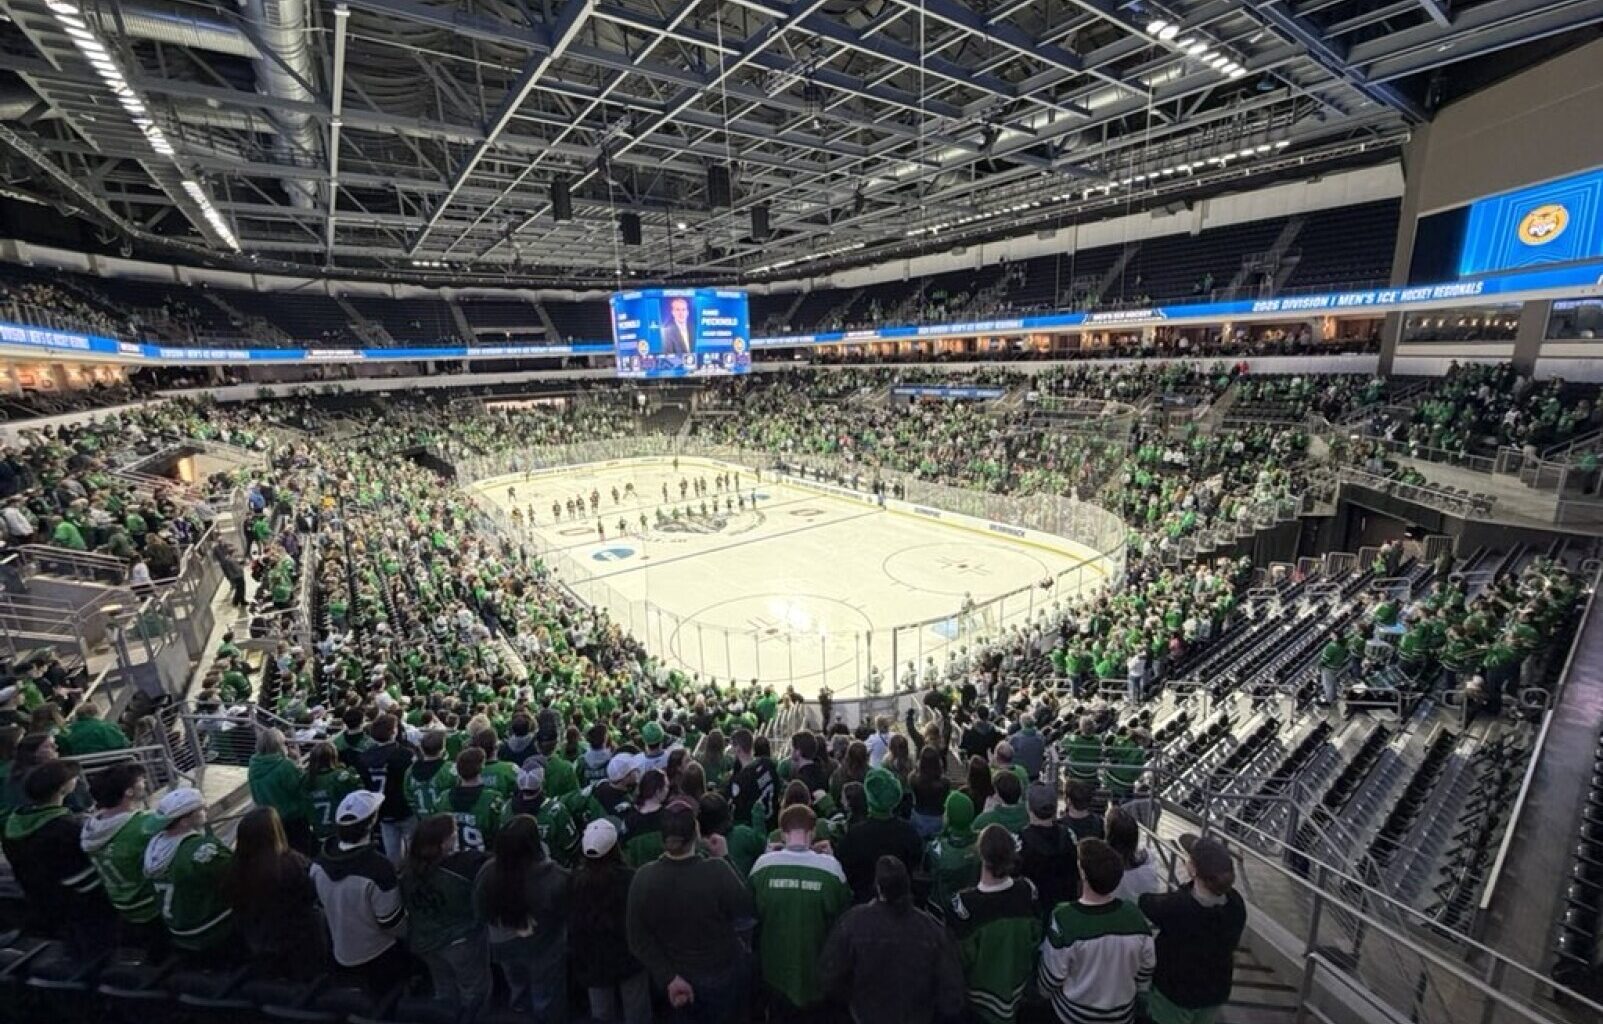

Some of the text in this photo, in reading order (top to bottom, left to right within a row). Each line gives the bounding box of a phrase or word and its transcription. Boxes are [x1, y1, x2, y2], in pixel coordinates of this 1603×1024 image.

[1281, 295, 1330, 310] DIVISION
[1337, 291, 1375, 306] MEN'S
[1400, 287, 1433, 301] HOCKEY
[1433, 280, 1484, 298] REGIONALS
[312, 800, 332, 825] 7
[152, 882, 175, 920] 7
